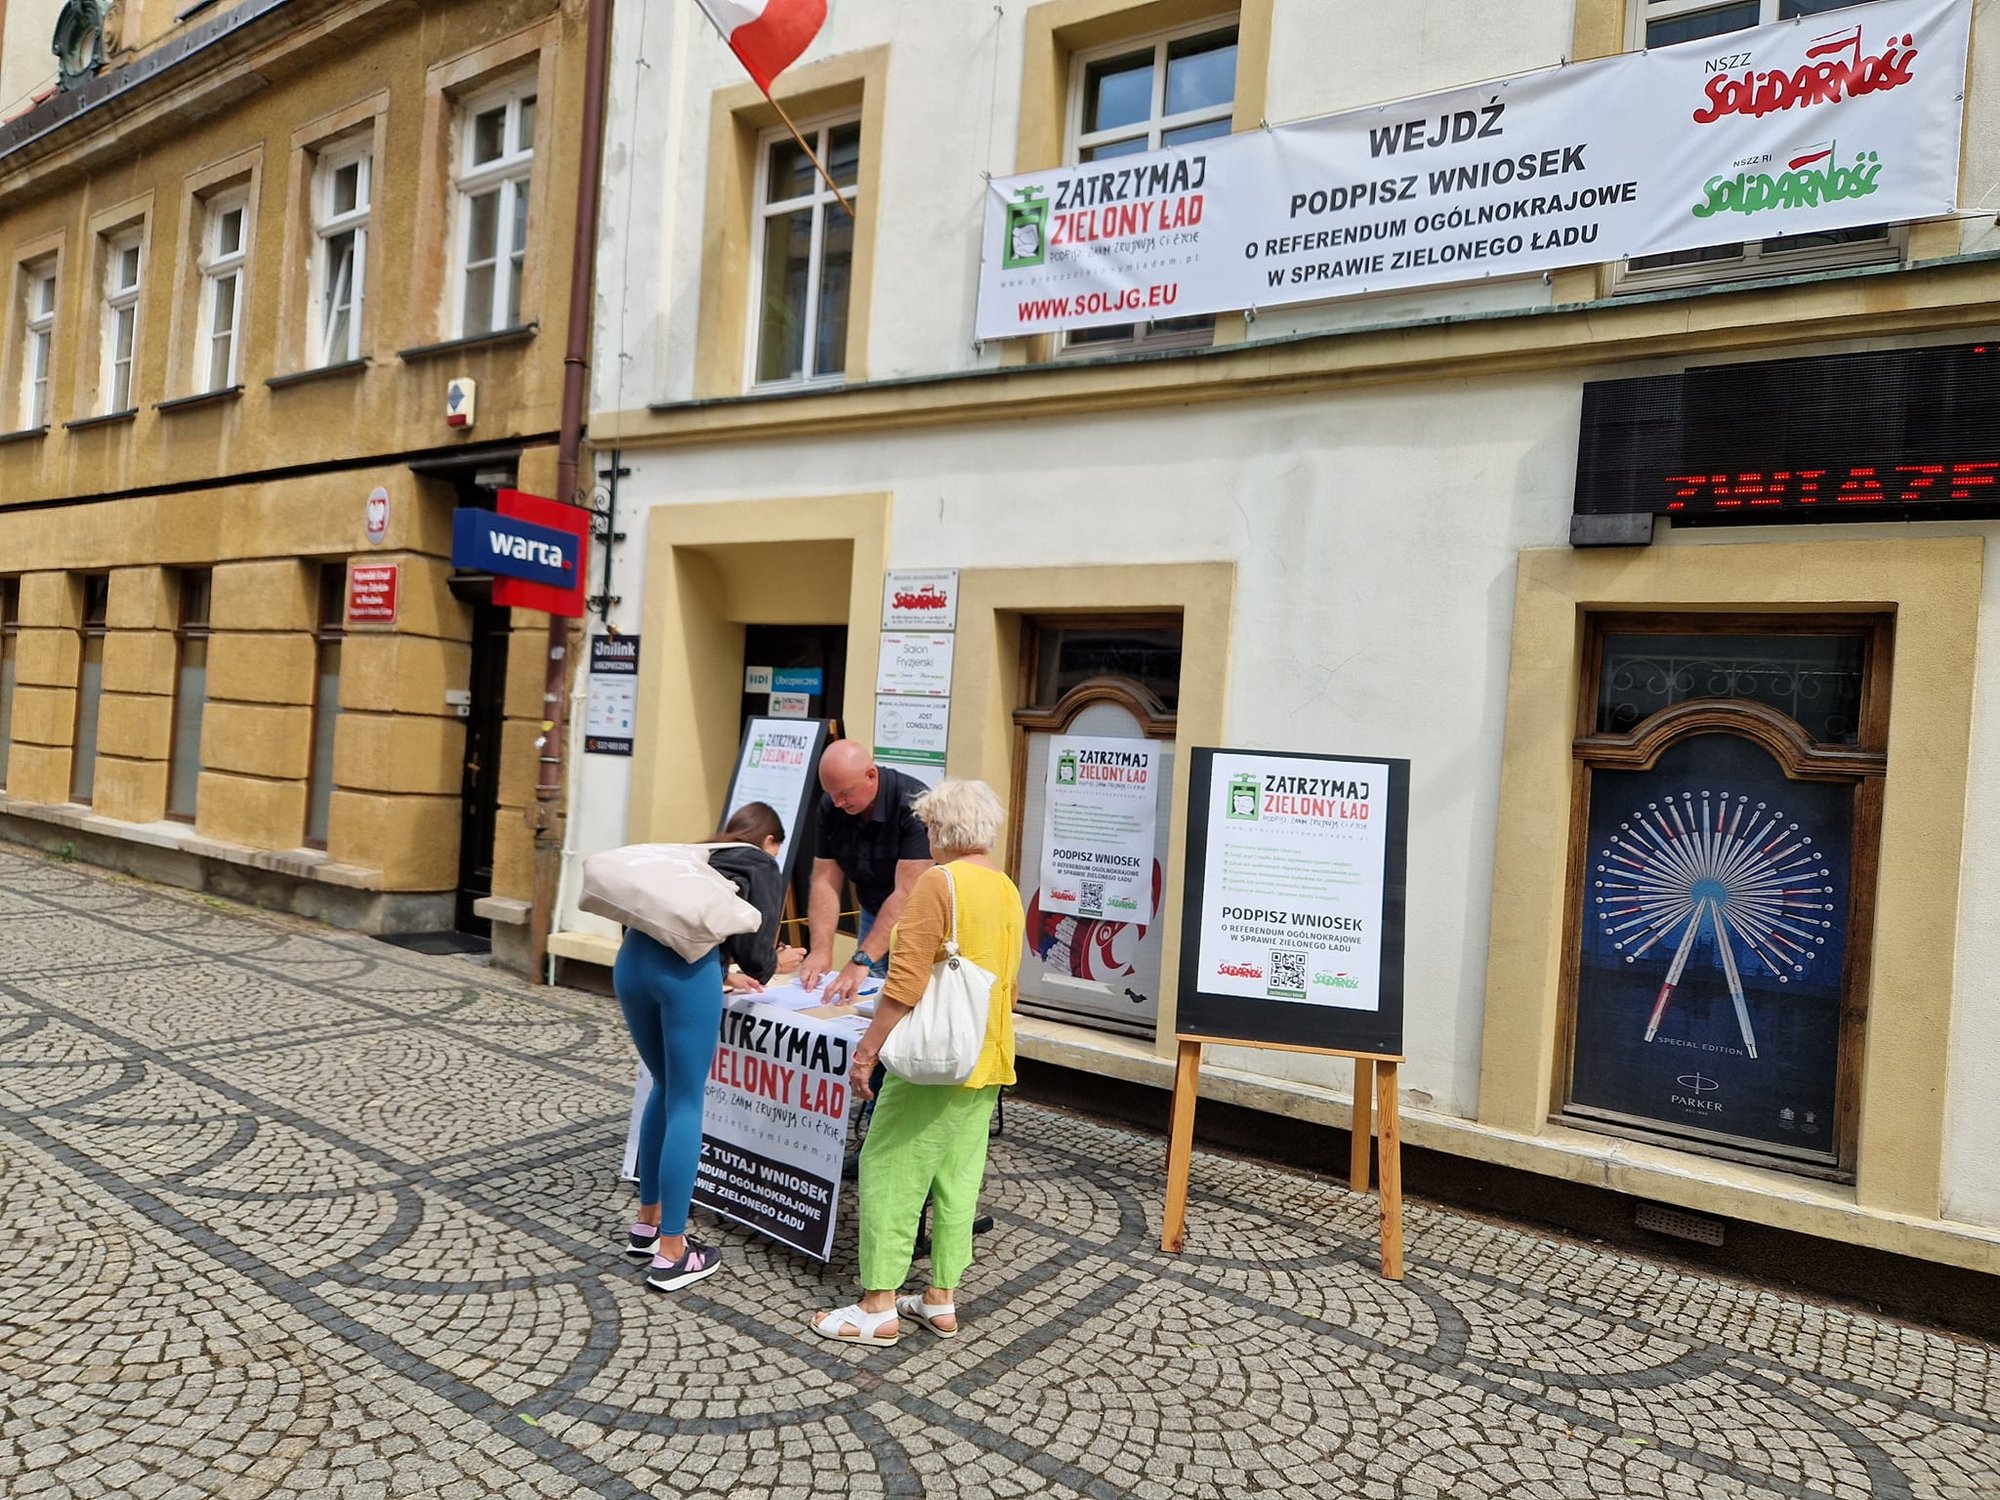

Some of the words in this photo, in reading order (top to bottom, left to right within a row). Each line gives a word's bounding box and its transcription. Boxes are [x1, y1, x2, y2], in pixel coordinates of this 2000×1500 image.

[1705, 52, 1752, 74] NSZZ
[1369, 95, 1506, 158] WEJDŹ
[1733, 156, 1760, 167] NSZZ
[1762, 154, 1772, 163] RI
[1055, 156, 1207, 210] ZATRZYMAJ
[1290, 175, 1418, 218] PODPISZ
[1428, 144, 1587, 195] WNIOSEK
[1050, 201, 1155, 246] ZIELONY
[1159, 195, 1204, 231] ŁAD
[1245, 242, 1259, 259] O
[1265, 218, 1407, 257] REFERENDUM
[1414, 181, 1637, 233] OGÓLNOKRAJOWE
[1267, 269, 1285, 287] W
[1290, 256, 1385, 285] SPRAWIE
[1390, 235, 1523, 270] ZIELONEGO
[1530, 223, 1599, 251] ŁADU
[1018, 283, 1178, 322] WWW.SOLJG.EU
[903, 643, 928, 654] Salon
[906, 722, 943, 731] CONSULTING
[1079, 750, 1148, 767] ZATRZYMAJ
[1079, 765, 1125, 781] ZIELONY
[1126, 769, 1147, 783] ŁAD
[1265, 775, 1370, 800] ZATRZYMAJ
[1264, 795, 1336, 818] ZIELONY
[1339, 802, 1369, 820] ŁAD
[1053, 849, 1093, 862] PODPISZ
[1095, 853, 1140, 867] WNIOSEK
[1057, 862, 1091, 871] REFERENDUM
[1092, 865, 1139, 877] OGÓLNOKRAJOWE
[1063, 869, 1085, 877] SPRAWIE
[1086, 872, 1116, 881] ZIELONEGO
[1222, 907, 1287, 924] PODPISZ
[1292, 913, 1363, 932] WNIOSEK
[1230, 925, 1285, 937] REFERENDUM
[1287, 930, 1362, 944] OGÓLNOKRAJOWE
[1240, 935, 1277, 945] SPRAWIE
[1279, 939, 1327, 950] ZIELONEGO
[1328, 944, 1351, 952] ŁADU
[720, 1008, 848, 1076] TRZYMAJ
[1657, 1036, 1699, 1049] SPECIAL
[1702, 1043, 1744, 1056] EDITION
[711, 1049, 794, 1106] IELONY
[800, 1073, 845, 1121] ŁAD
[755, 1101, 798, 1128] ZRUJNUJĄ
[1671, 1094, 1723, 1112] PARKER
[713, 1147, 756, 1174] TUTAJ
[760, 1165, 829, 1204] WNIOSEK
[717, 1185, 776, 1218] ZIELONEGO
[777, 1211, 805, 1231] ŁADU
[729, 1174, 821, 1220] OGÓLNOKRAJOWE
